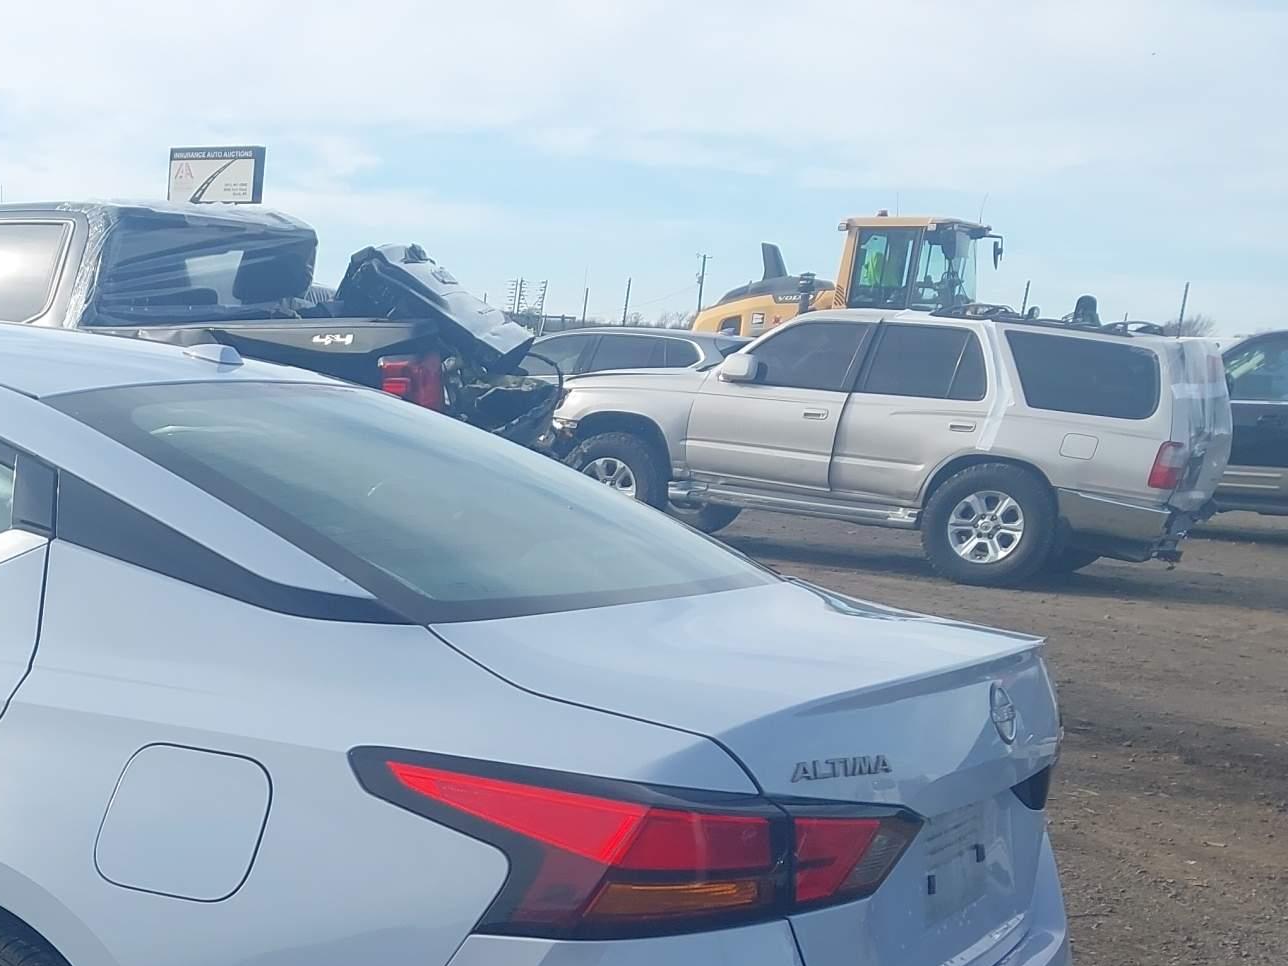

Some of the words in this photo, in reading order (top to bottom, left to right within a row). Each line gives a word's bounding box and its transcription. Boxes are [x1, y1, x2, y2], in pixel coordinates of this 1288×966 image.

[173, 151, 206, 159] INSURANCE
[223, 150, 253, 158] AUCTIONS
[790, 753, 893, 783] ALTIMA
